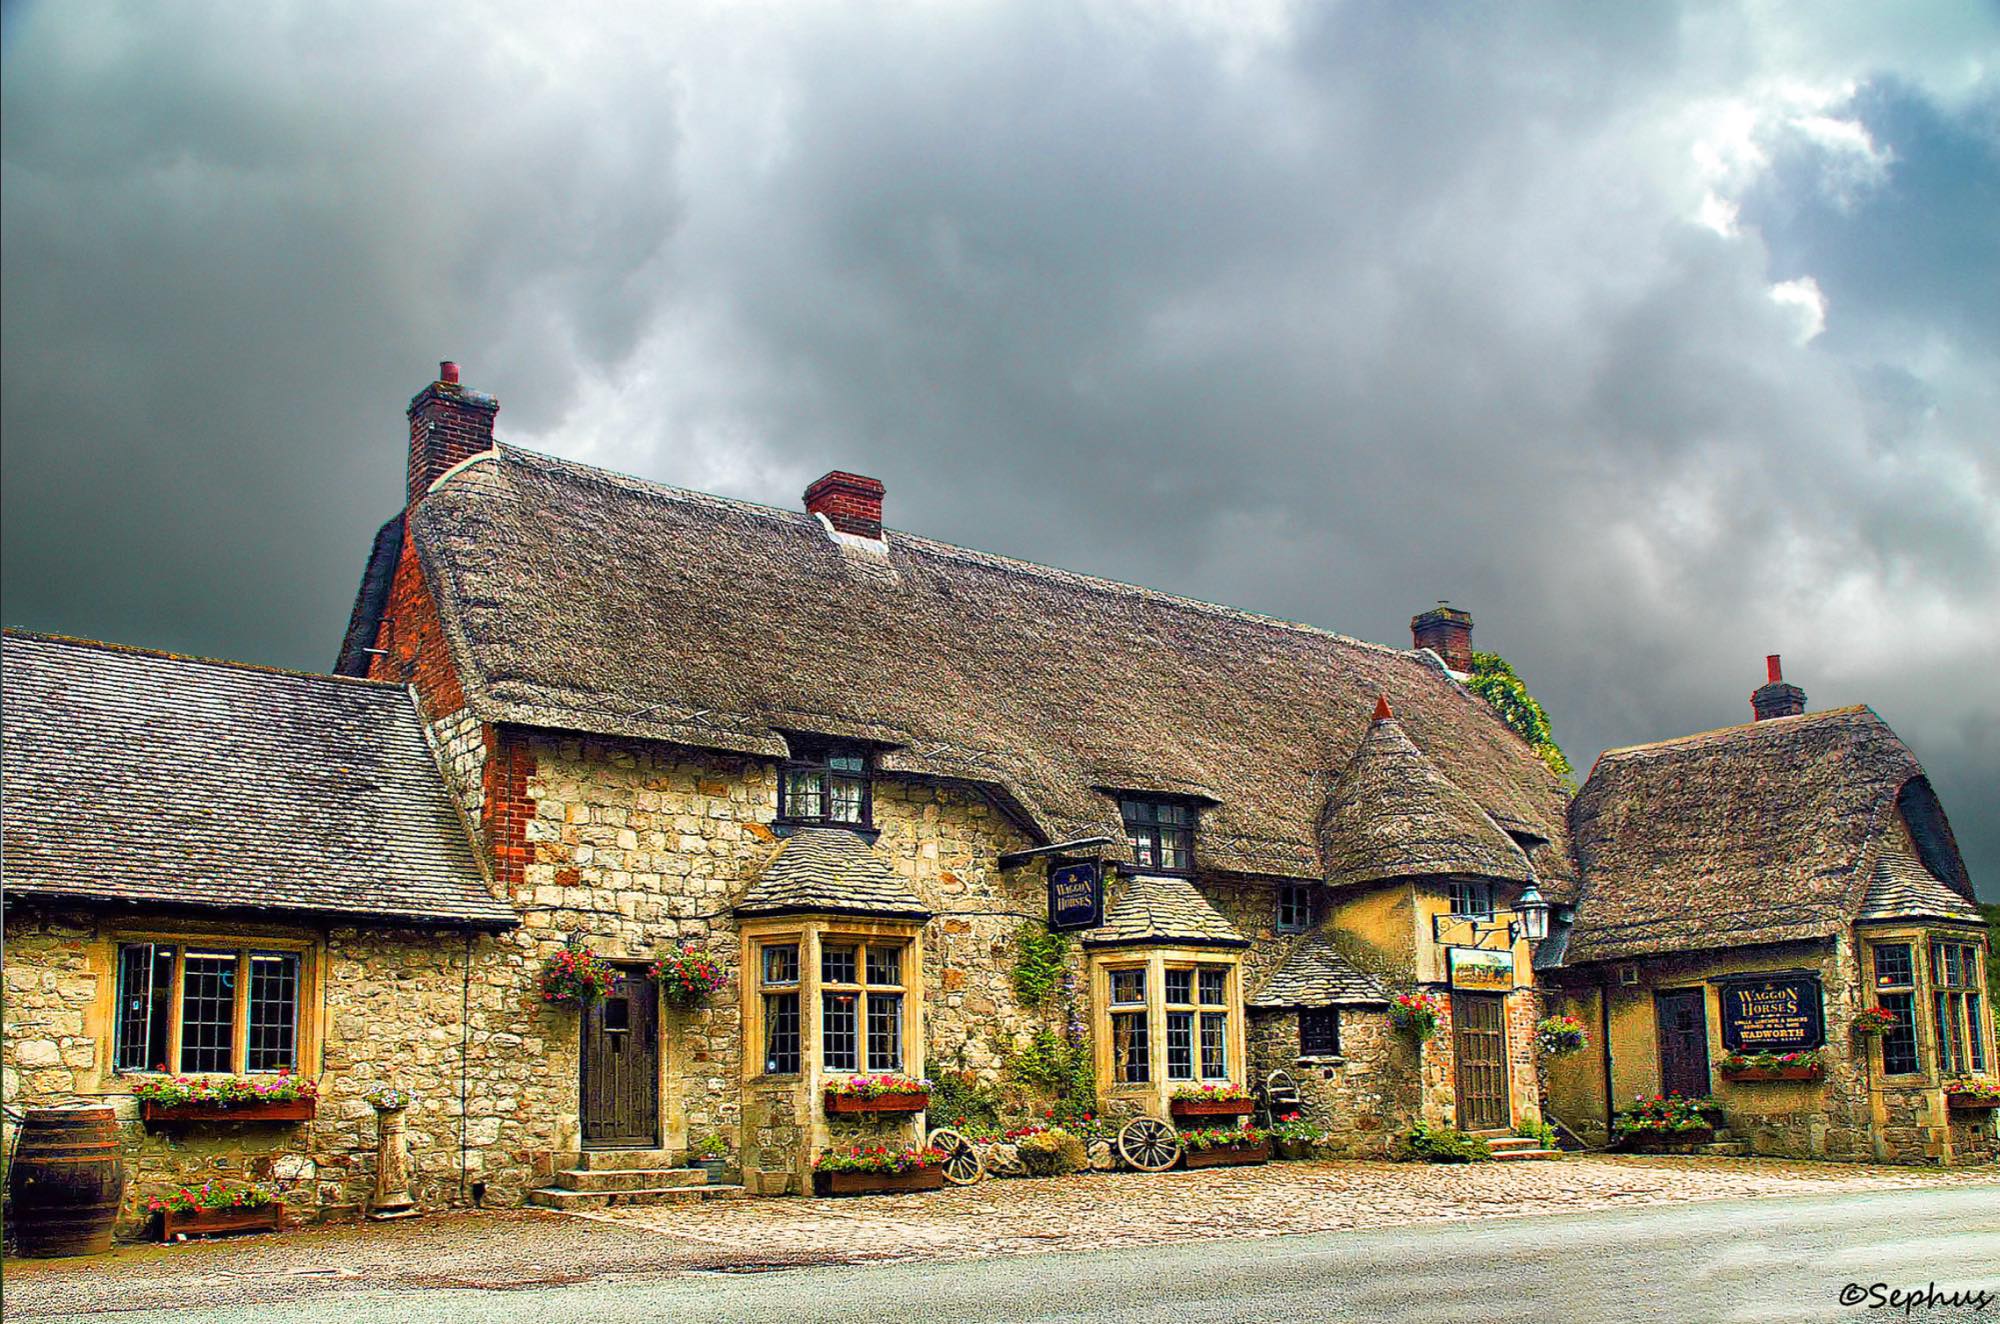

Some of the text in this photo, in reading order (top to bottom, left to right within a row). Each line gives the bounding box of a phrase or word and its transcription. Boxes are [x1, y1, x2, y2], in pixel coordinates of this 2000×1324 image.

[1738, 987, 1798, 1002] WAGGON
[1742, 1000, 1798, 1016] HORSES
[1740, 1029, 1805, 1039] WADWORTH
